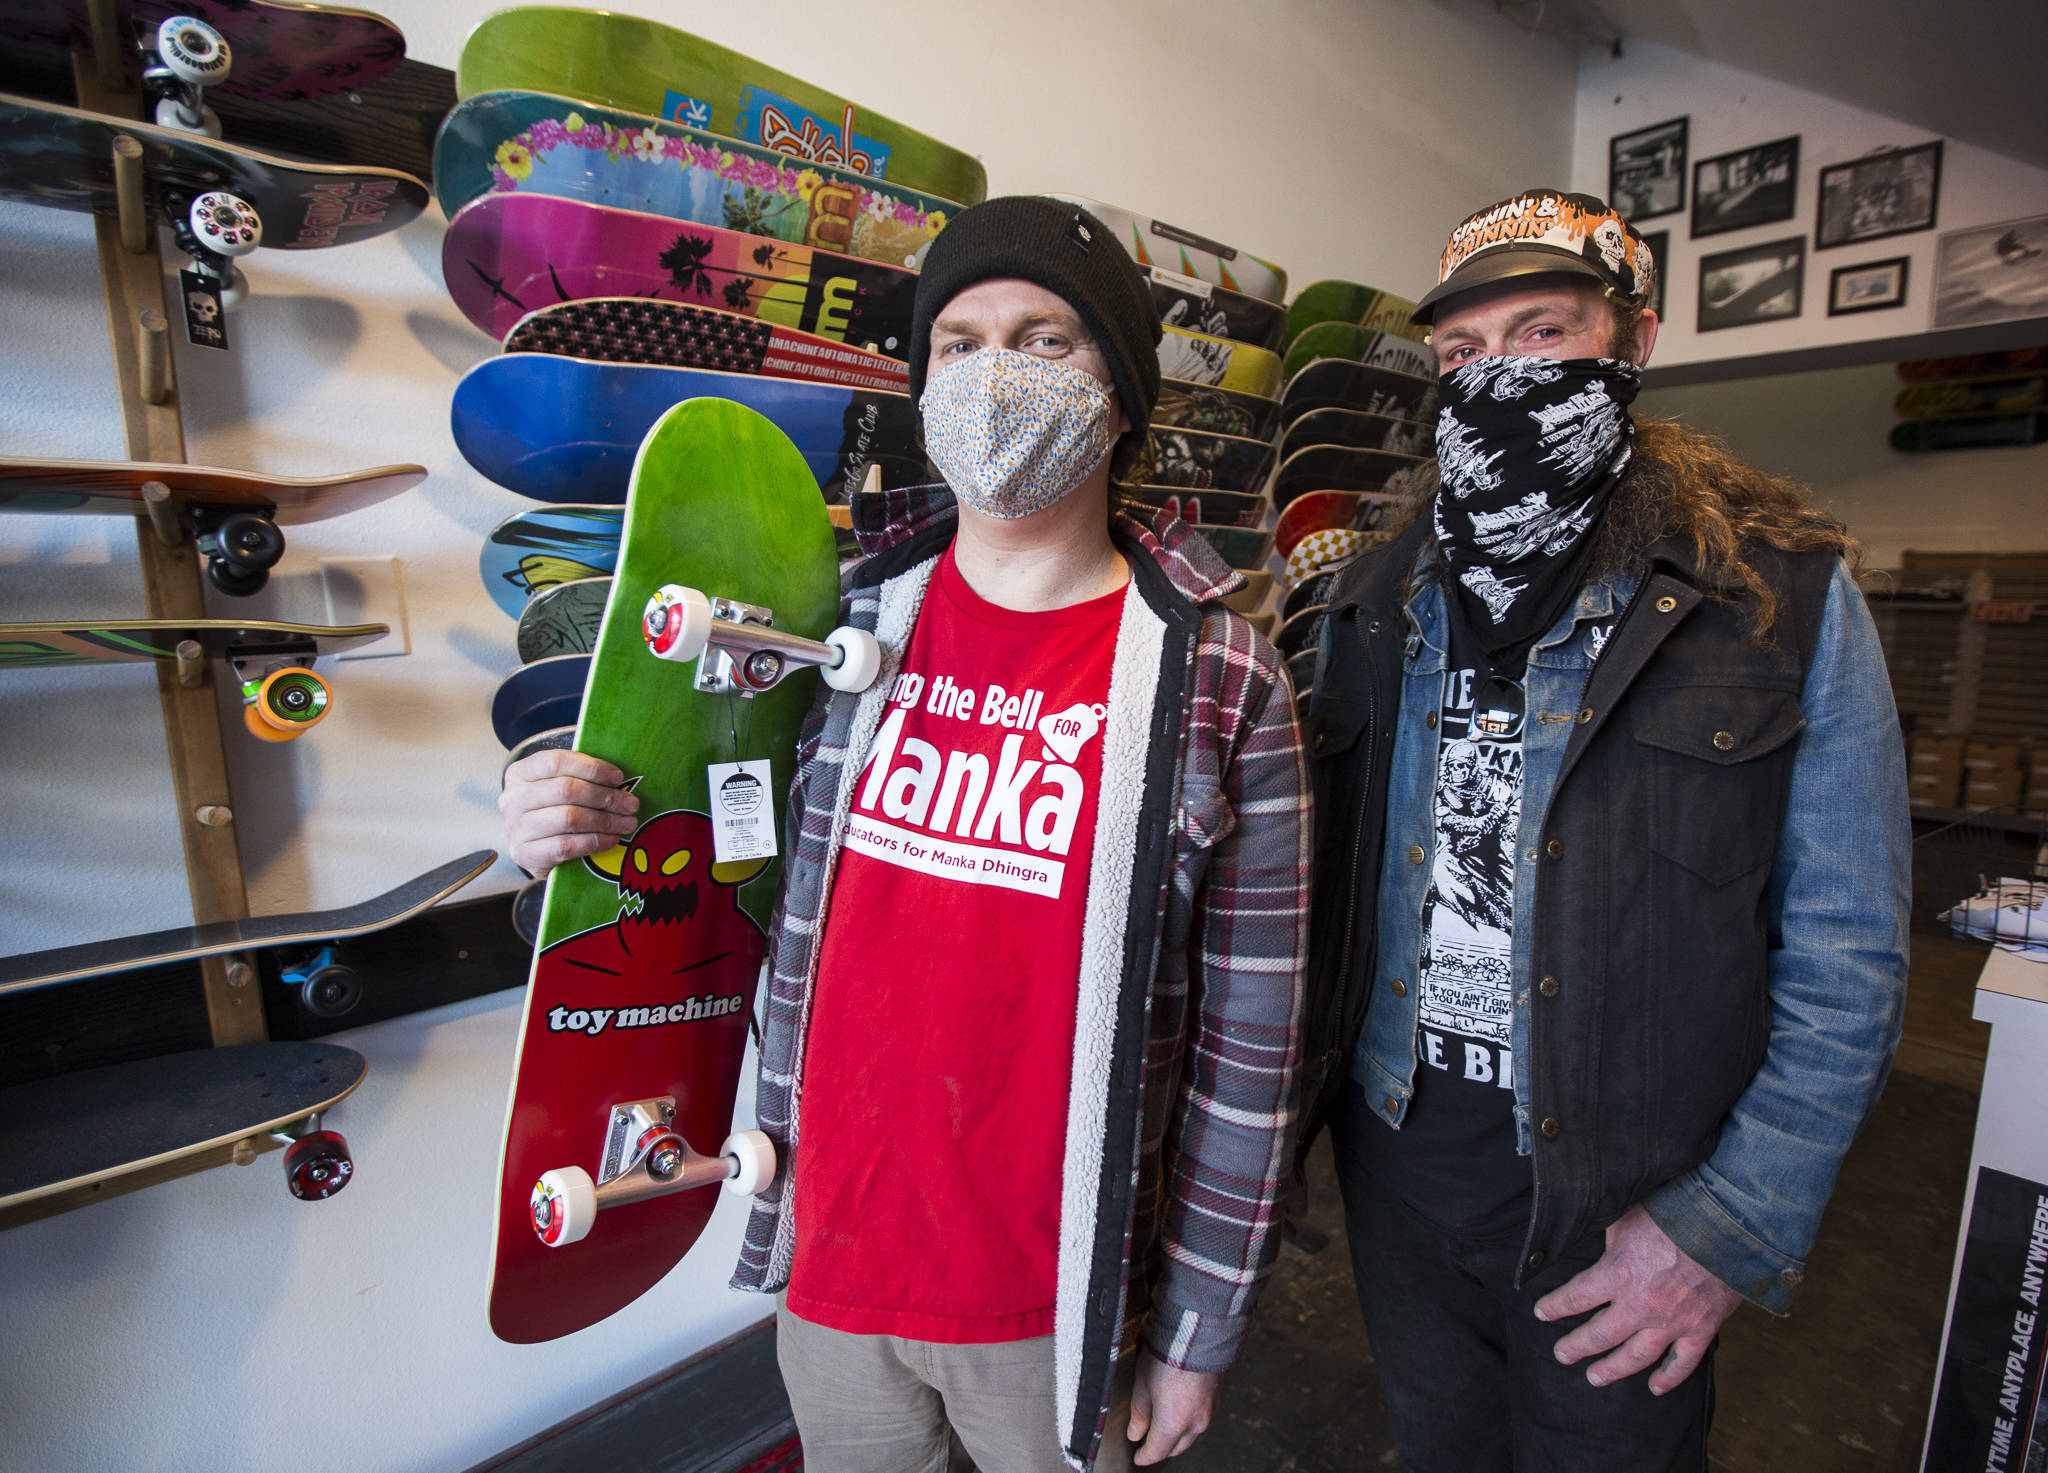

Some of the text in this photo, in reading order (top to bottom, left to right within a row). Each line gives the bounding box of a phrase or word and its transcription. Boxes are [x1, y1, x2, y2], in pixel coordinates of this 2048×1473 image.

[285, 182, 355, 247] MAIDEN
[346, 181, 398, 227] IRON
[1535, 197, 1560, 217] &
[926, 675, 976, 722] the
[979, 684, 1045, 731] Bell
[1052, 718, 1082, 738] FOR
[725, 780, 757, 789] WARNING
[903, 841, 928, 859] for
[930, 849, 976, 870] Manka
[982, 858, 1049, 883] Dhingra
[548, 993, 744, 1036] toy machine
[1429, 984, 1439, 993] IF
[1440, 988, 1461, 999] YOU
[1463, 993, 1490, 1004] AIN'T
[1433, 993, 1453, 1004] YOU
[1455, 998, 1481, 1010] AIN'T
[1999, 1309, 2040, 1415] ANYPLACE,
